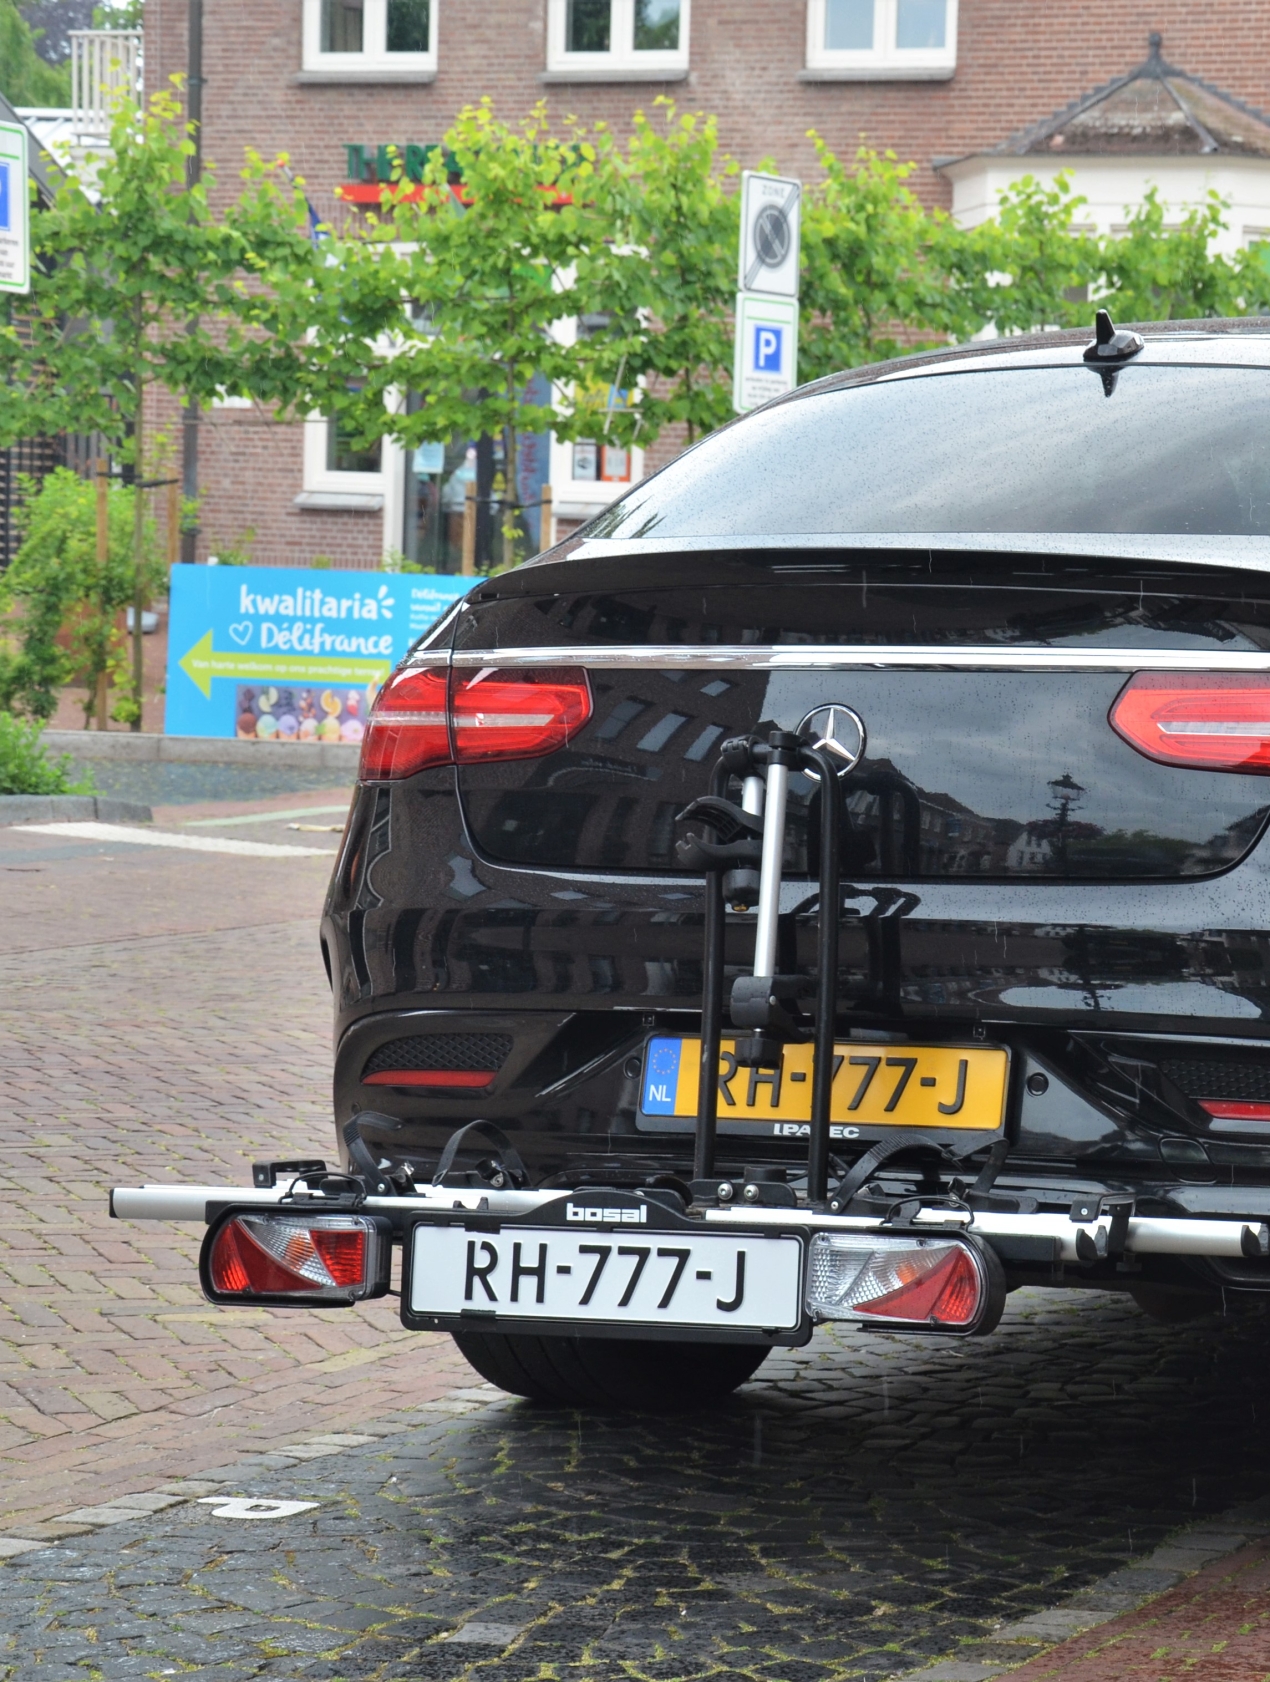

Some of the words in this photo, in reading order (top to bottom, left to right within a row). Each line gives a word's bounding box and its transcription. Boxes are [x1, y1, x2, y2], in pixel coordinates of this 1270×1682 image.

[758, 330, 778, 368] P
[239, 584, 379, 621] kwalitaria
[260, 621, 394, 655] Délifrance
[649, 1084, 672, 1102] NL
[773, 1123, 860, 1139] IPAEC
[566, 1202, 647, 1223] bosal
[464, 1239, 747, 1312] RH-777-J
